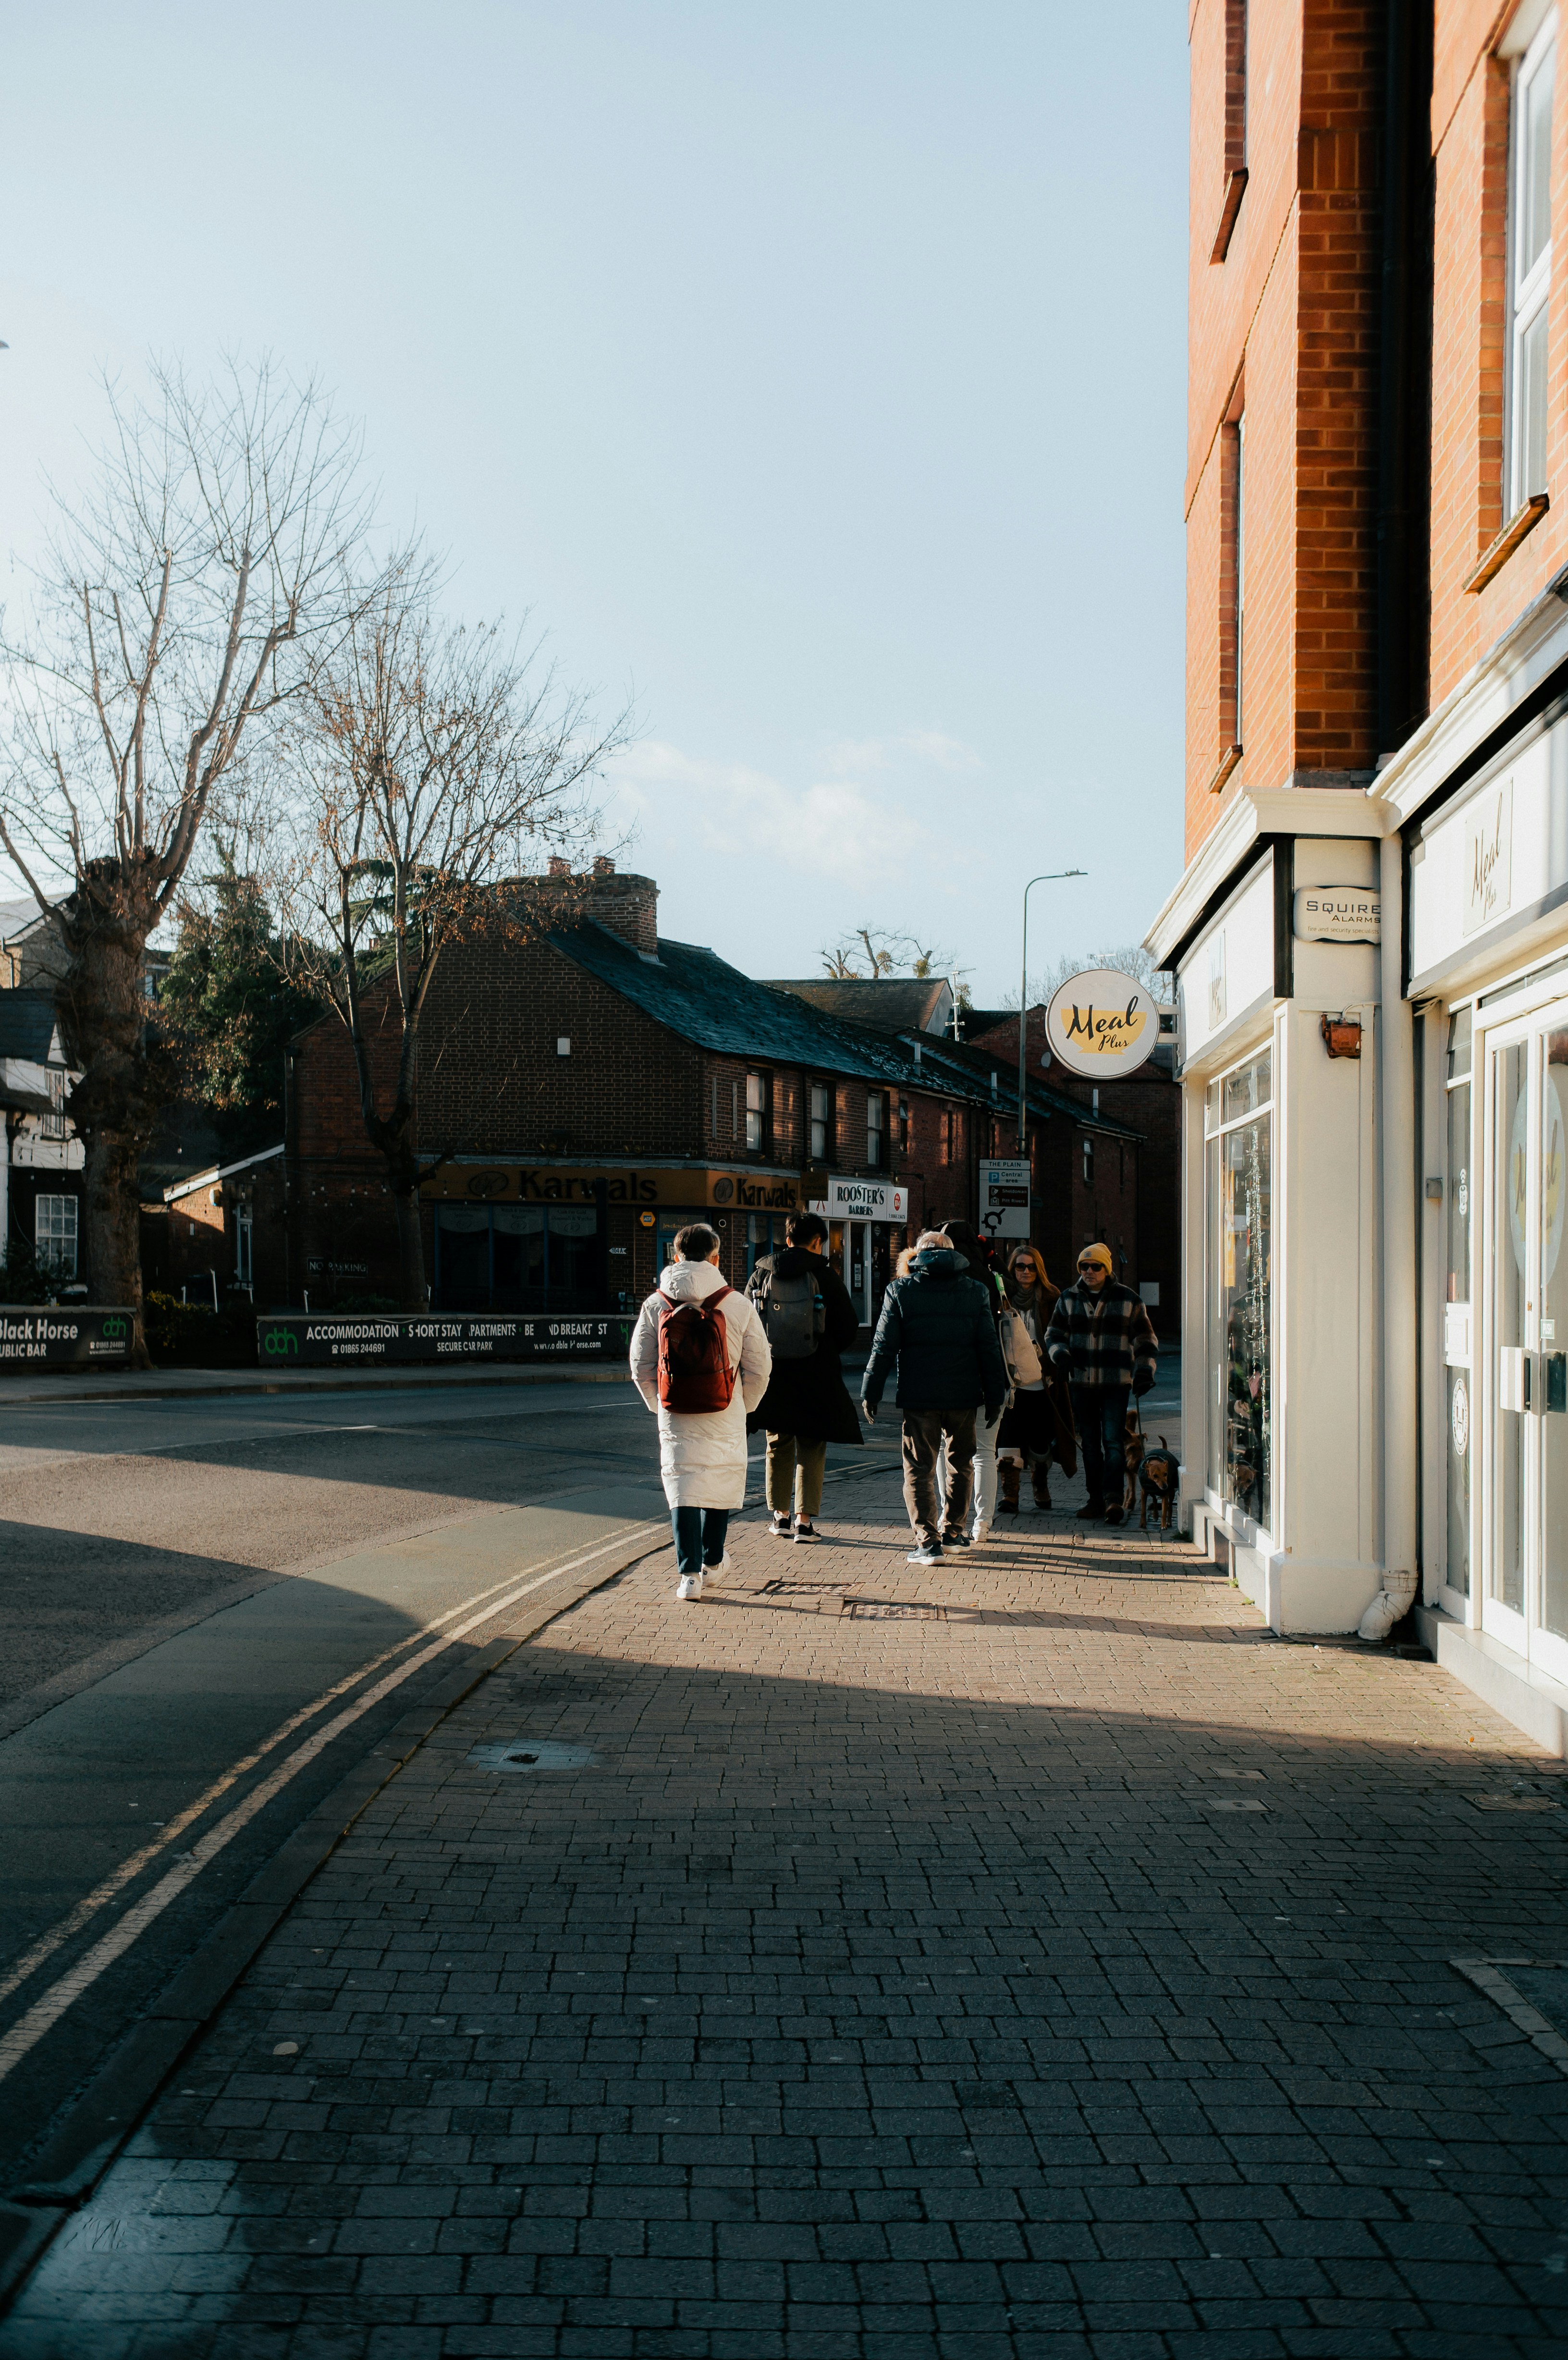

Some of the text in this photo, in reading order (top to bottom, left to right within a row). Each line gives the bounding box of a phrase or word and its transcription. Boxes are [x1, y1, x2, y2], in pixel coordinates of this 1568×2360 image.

[1332, 915, 1381, 923] ALARMS
[1066, 995, 1139, 1040] Meal
[1098, 1033, 1129, 1052] Plus
[736, 1178, 796, 1208] Karwals
[837, 1185, 884, 1205] ROOSTER'S
[848, 1205, 873, 1216] BARBERS
[309, 1261, 324, 1271] NO
[37, 1318, 78, 1340] Horse
[306, 1324, 399, 1340] ACCOMMODATION
[441, 1324, 462, 1337] STAY
[469, 1324, 516, 1337] PARTMENTS
[561, 1323, 608, 1336] BREAKFST
[27, 1343, 47, 1357] BAR
[340, 1343, 385, 1353] 01865 244691
[437, 1342, 462, 1352] SECURE
[477, 1341, 493, 1351] PARK
